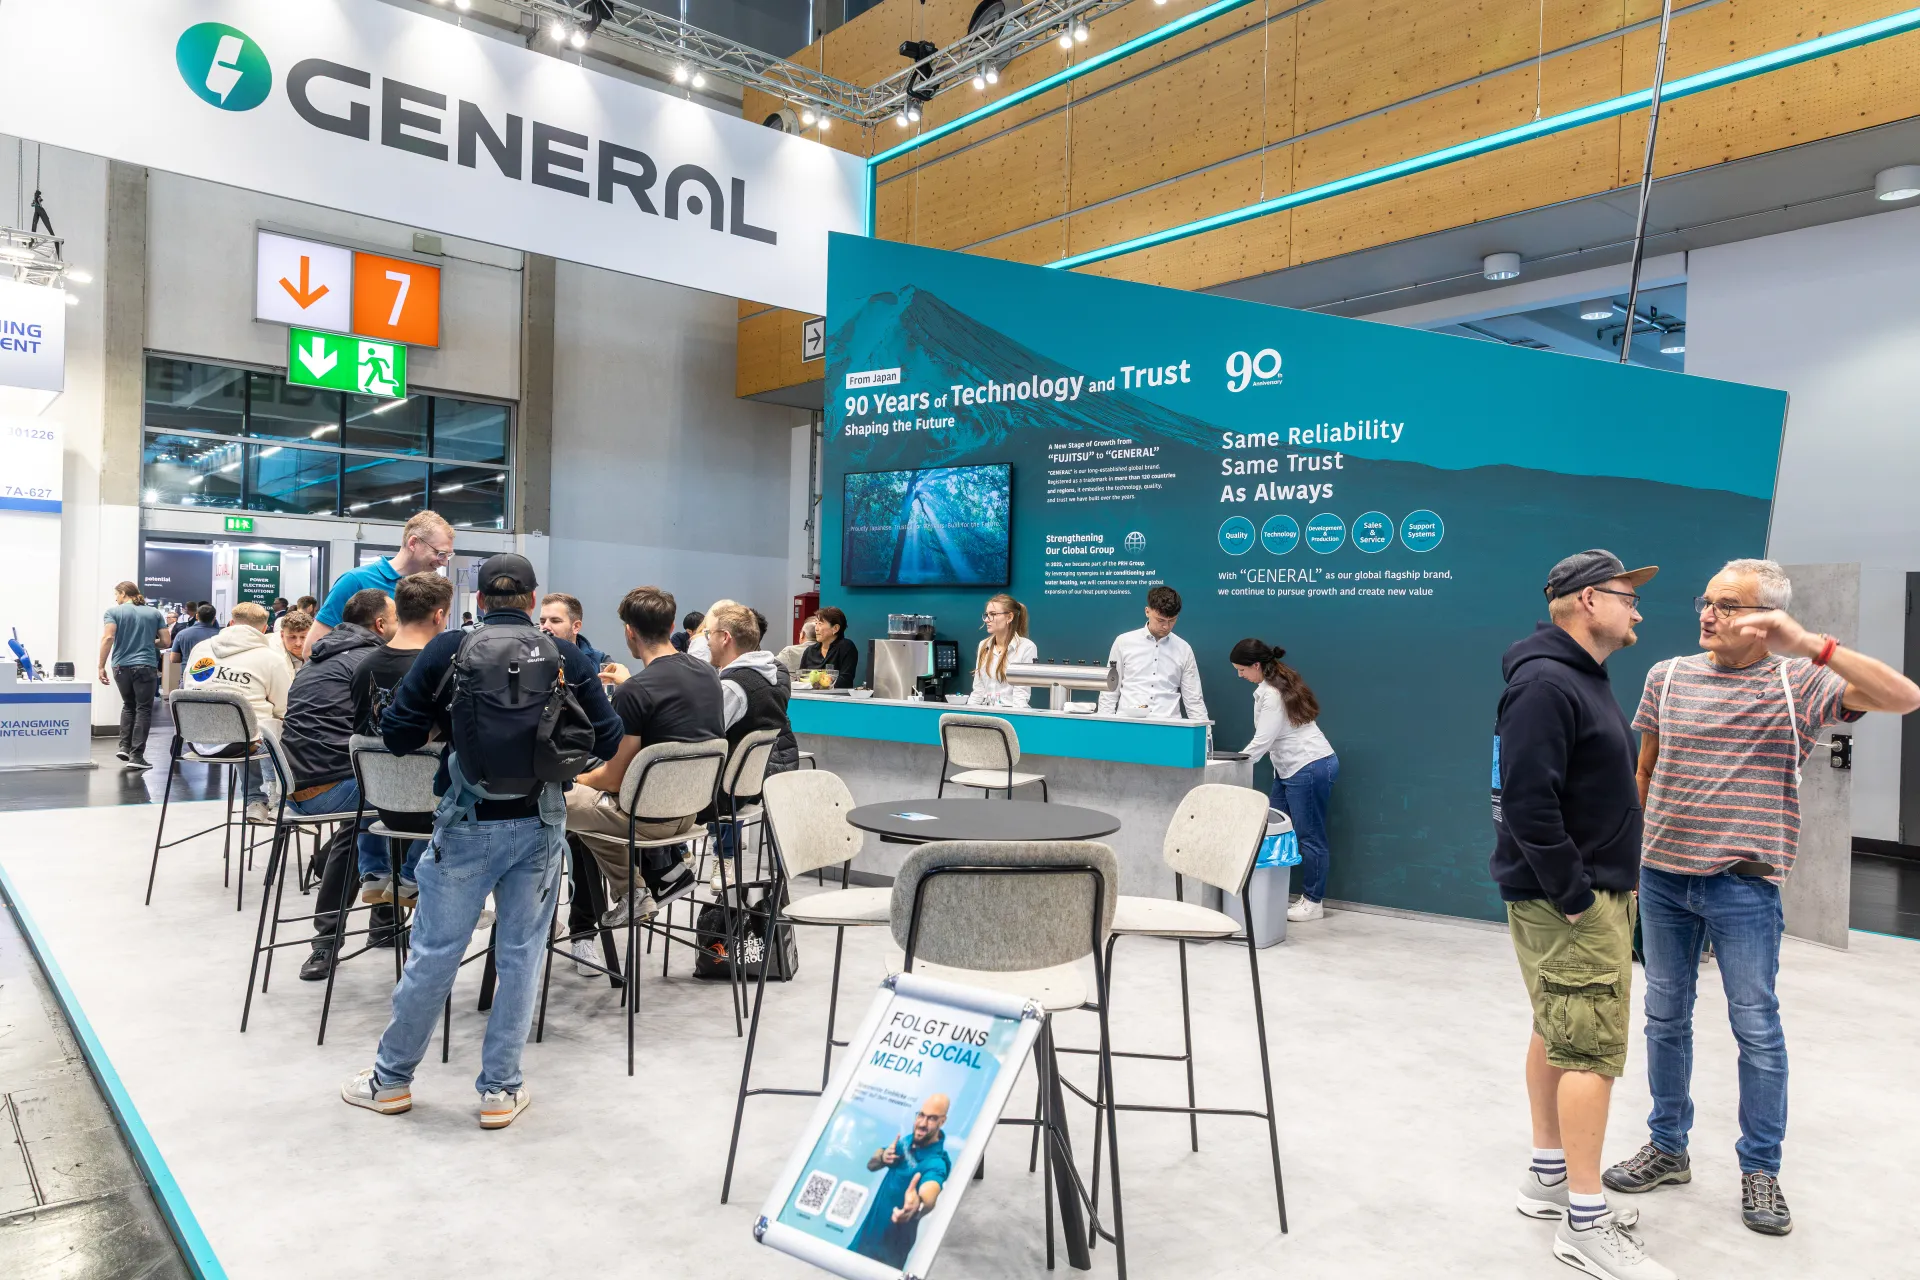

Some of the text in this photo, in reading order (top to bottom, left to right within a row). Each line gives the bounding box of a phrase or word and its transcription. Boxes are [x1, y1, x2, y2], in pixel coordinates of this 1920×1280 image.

[286, 58, 778, 246] GENERAL
[385, 271, 411, 326] 7
[0, 320, 42, 338] ING
[849, 371, 897, 385] From Japan
[1226, 348, 1282, 392] 90
[845, 359, 1191, 417] 90 Years of Technology and Trust
[845, 416, 955, 438] Shaping the Future
[1222, 419, 1405, 450] Same Reliability
[1048, 451, 1094, 463] “FUJITSU”
[1106, 447, 1160, 459] “GENERAL”
[1221, 452, 1344, 476] Same Trust
[6, 486, 52, 498] 7A-627
[1220, 482, 1333, 504] As Always
[1046, 533, 1103, 544] Strengthening
[1225, 531, 1248, 540] Quality
[1062, 546, 1087, 554] Global
[1090, 546, 1114, 555] Group
[1218, 571, 1237, 580] With
[1240, 568, 1322, 583] “GENERAL”
[1355, 570, 1381, 581] global
[1384, 570, 1420, 581] flagship
[1423, 570, 1453, 580] brand,
[1231, 587, 1264, 596] continue
[1278, 588, 1305, 597] pursue
[1308, 587, 1338, 597] growth
[1340, 587, 1355, 595] and
[1358, 587, 1385, 595] create
[1408, 587, 1433, 596] value
[216, 666, 252, 684] KuS
[1, 720, 69, 728] XIANGMING
[737, 953, 763, 964] ROU
[890, 1012, 990, 1046] FOLGT UNS
[879, 1031, 982, 1070] AUF SOCIAL
[870, 1050, 922, 1078] MEDIA
